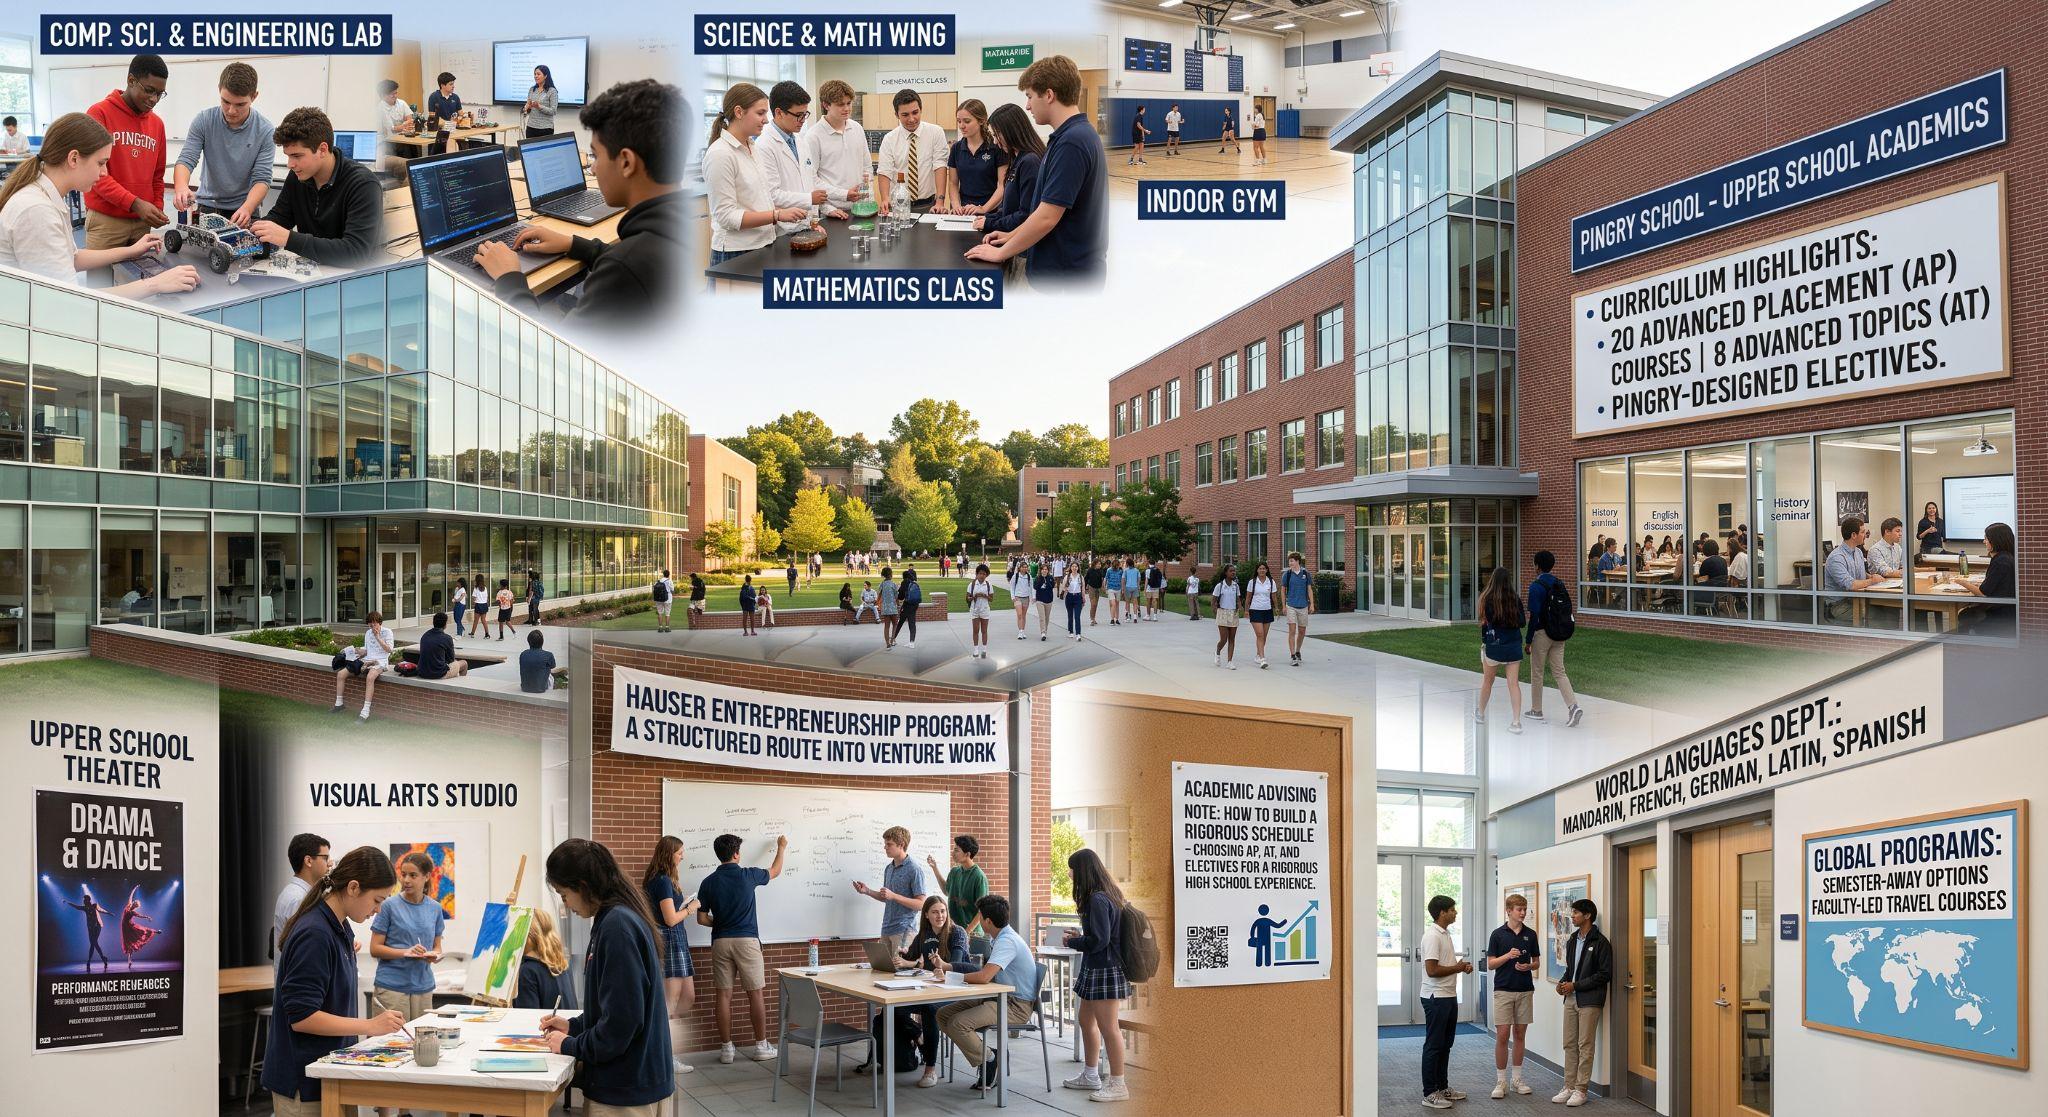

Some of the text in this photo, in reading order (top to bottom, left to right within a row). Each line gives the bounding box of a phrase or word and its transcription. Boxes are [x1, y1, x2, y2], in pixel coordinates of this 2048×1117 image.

[1582, 214, 1635, 254] PINGRY
[1641, 193, 1704, 235] SCHOOL
[1724, 167, 1779, 208] UPPER
[1786, 141, 1860, 188] SCHOOL
[1867, 97, 1988, 163] ACADEMICS
[1602, 231, 1877, 322] CURRICULUM HIGHLIGHTS:
[1612, 249, 1956, 354] 20 ADVANCED PLACEMENT (AP)
[1612, 348, 1691, 385] COURSES
[1715, 341, 1726, 366] 8
[1732, 318, 1841, 363] ADVANCED
[1849, 299, 1931, 341] TOPICS
[1940, 286, 1989, 326] (AT)
[1613, 339, 1945, 419] PINGRY-DESIGNED ELECTIVES.
[1592, 508, 1618, 518] History
[1652, 510, 1679, 521] English
[1770, 511, 1811, 521] seminar
[1774, 498, 1810, 509] History
[627, 684, 995, 737] HAUSER ENTREPRENEURSHIP PROGRAM:
[31, 720, 194, 761] UPPER SCHOOL
[626, 716, 995, 764] A STRUCTURED ROUTE INTO VENTURE WORK
[1596, 697, 1841, 802] WORLD LANGUAGES DEPT.:
[64, 755, 160, 789] THEATER
[1564, 706, 1925, 835] MANDARIN, FRENCH, GERMAN, LATIN, SPANISH
[310, 783, 517, 807] VISUAL ARTS STUDIO
[1184, 780, 1316, 803] ACADEMIC ADVISING
[72, 803, 154, 837] DRAMA
[1185, 804, 1317, 824] NOTE: HOW TO BUILD A
[1185, 823, 1314, 842] RIGOROUS SCHEDULE
[63, 838, 161, 870] & DANCE
[1194, 844, 1243, 856] CHOOSING
[1247, 845, 1260, 858] AP,
[1264, 846, 1276, 859] AT,
[1280, 846, 1299, 858] AND
[1815, 827, 2001, 872] GLOBAL PROGRAMS:
[1186, 860, 1318, 873] ELECTIVES FOR A RIGOROUS
[1823, 865, 1988, 893] SEMESTER-AWAY OPTIONS
[1186, 876, 1316, 889] HIGH SCHOOL EXPERIENCE.
[1813, 890, 2006, 915] FACULTY-LED TRAVEL COURSES
[51, 980, 119, 995] PERFORMANCE
